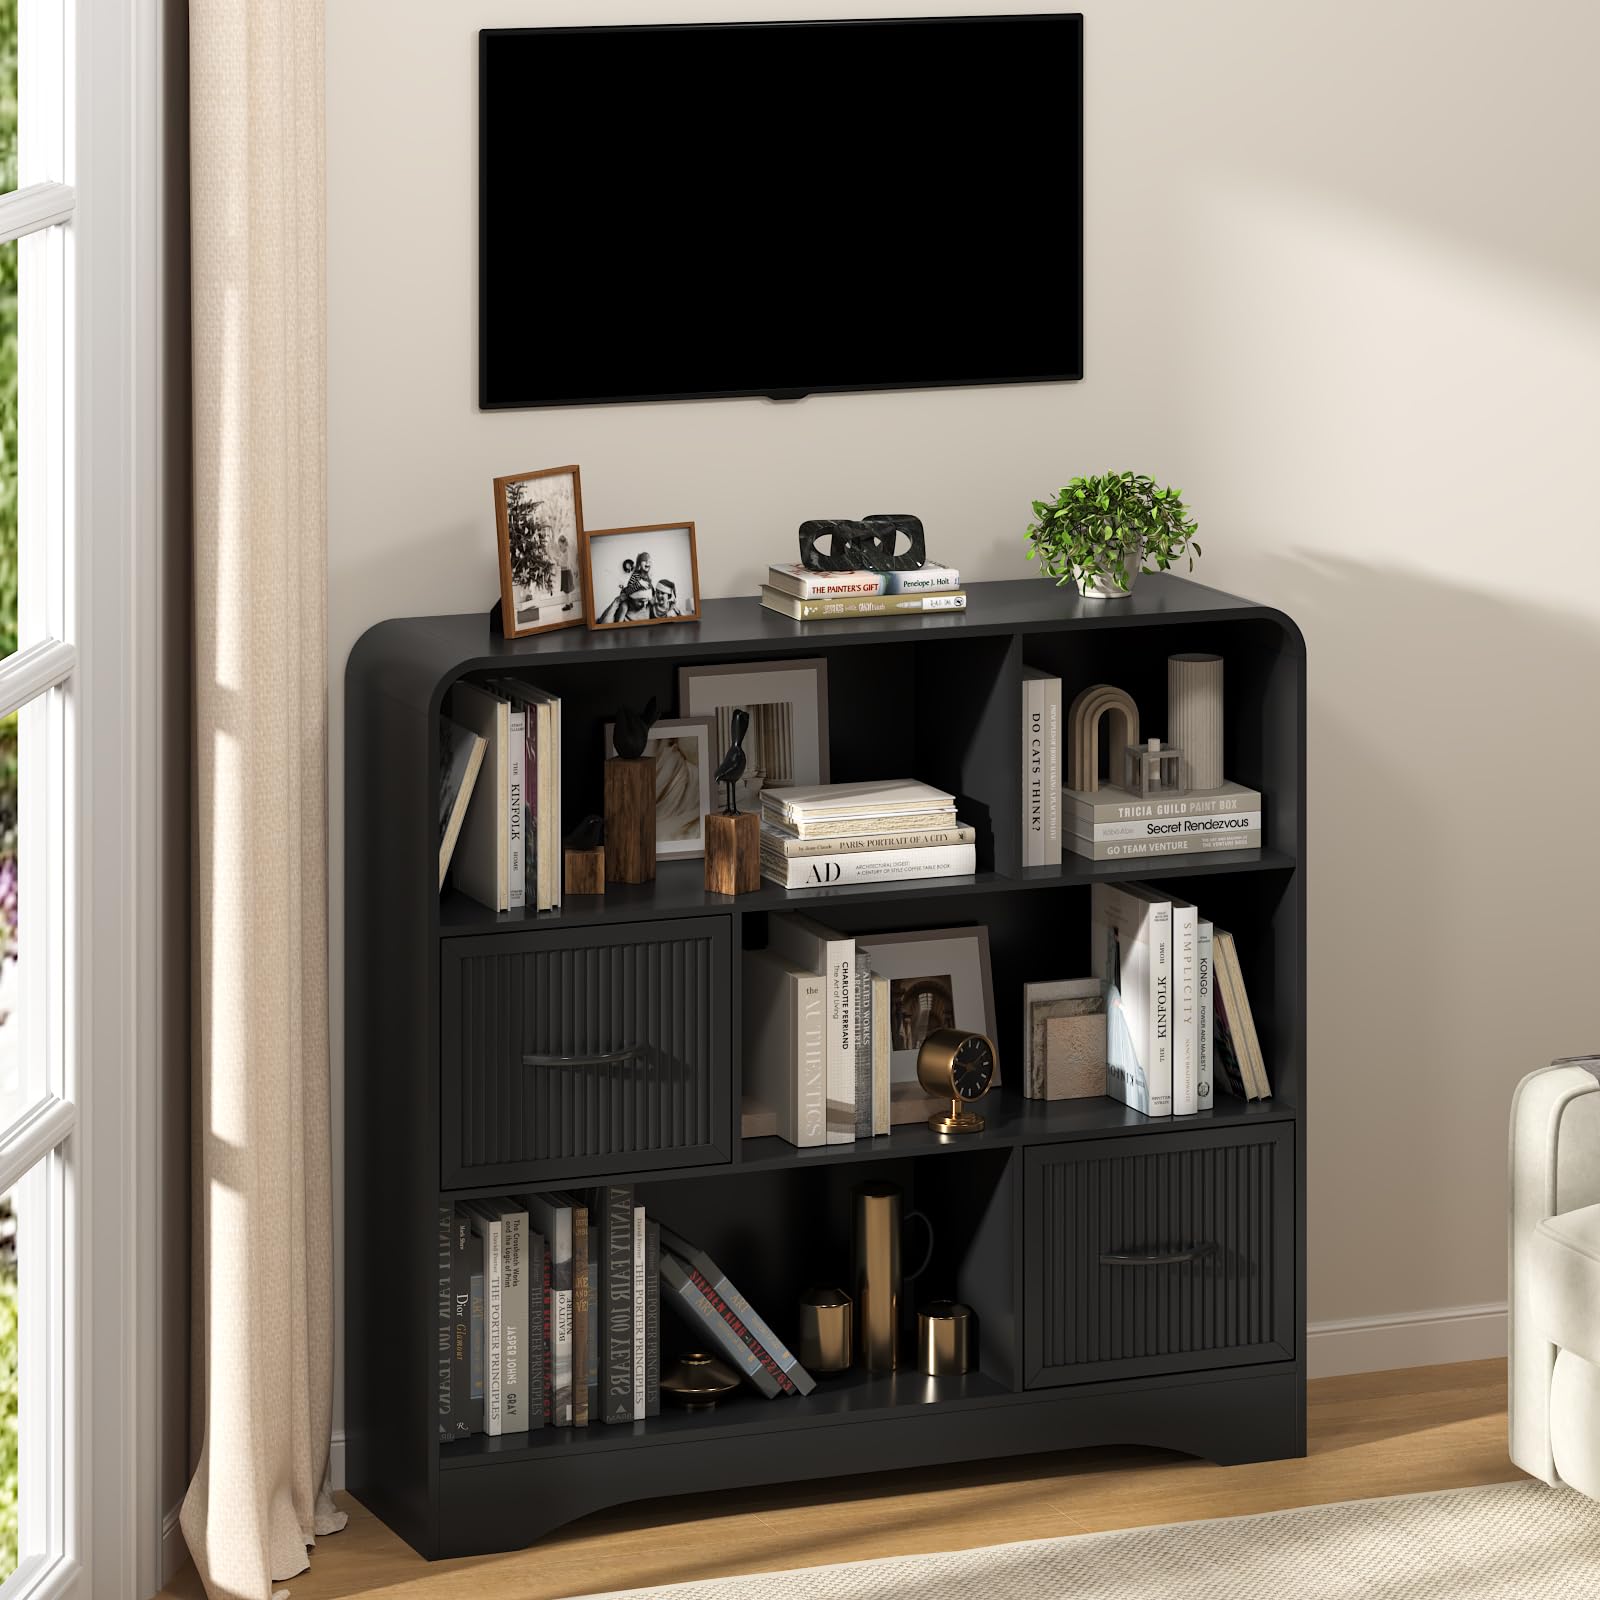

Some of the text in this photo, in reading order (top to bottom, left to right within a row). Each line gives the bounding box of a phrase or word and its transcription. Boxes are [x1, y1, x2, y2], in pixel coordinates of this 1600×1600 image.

[812, 583, 879, 594] THE PAINTER'S GIFT
[903, 578, 930, 588] Penelope
[936, 577, 950, 586] Holt
[1032, 713, 1041, 832] DO CATS THINK?
[511, 784, 520, 841] KINFOLK
[1118, 799, 1238, 818] TRICIA GUILD PAINT BOX
[1147, 818, 1249, 835] Secret Rendezvous
[867, 836, 908, 848] PORTRAIT
[909, 835, 921, 845] OF
[922, 835, 929, 844] A
[930, 833, 950, 843] CITY
[1107, 840, 1188, 855] GO TEAM VENTURE
[806, 862, 841, 884] AD
[806, 986, 819, 995] the
[1183, 922, 1192, 1024] SIMPLICITY
[1200, 958, 1208, 998] KONGO:
[832, 999, 840, 1020] Living
[1157, 976, 1167, 1040] KINFOLK
[804, 998, 822, 1136] AUTHENTICS
[504, 1247, 512, 1263] Logic
[492, 1276, 500, 1301] THE
[504, 1273, 512, 1288] Print
[512, 1269, 520, 1287] Works
[635, 1264, 644, 1286] THE
[456, 1293, 468, 1360] Dior Glamour
[492, 1304, 500, 1350] PORTER
[558, 1292, 566, 1342] BEAUTY OF
[635, 1290, 644, 1334] PORTER
[648, 1299, 657, 1338] PORTER
[492, 1353, 500, 1420] PRINCIPLES
[506, 1326, 517, 1416] JASPER JOHNS GRAY
[635, 1338, 644, 1405] PRINCIPLES
[648, 1342, 657, 1404] PRINCIPLES
